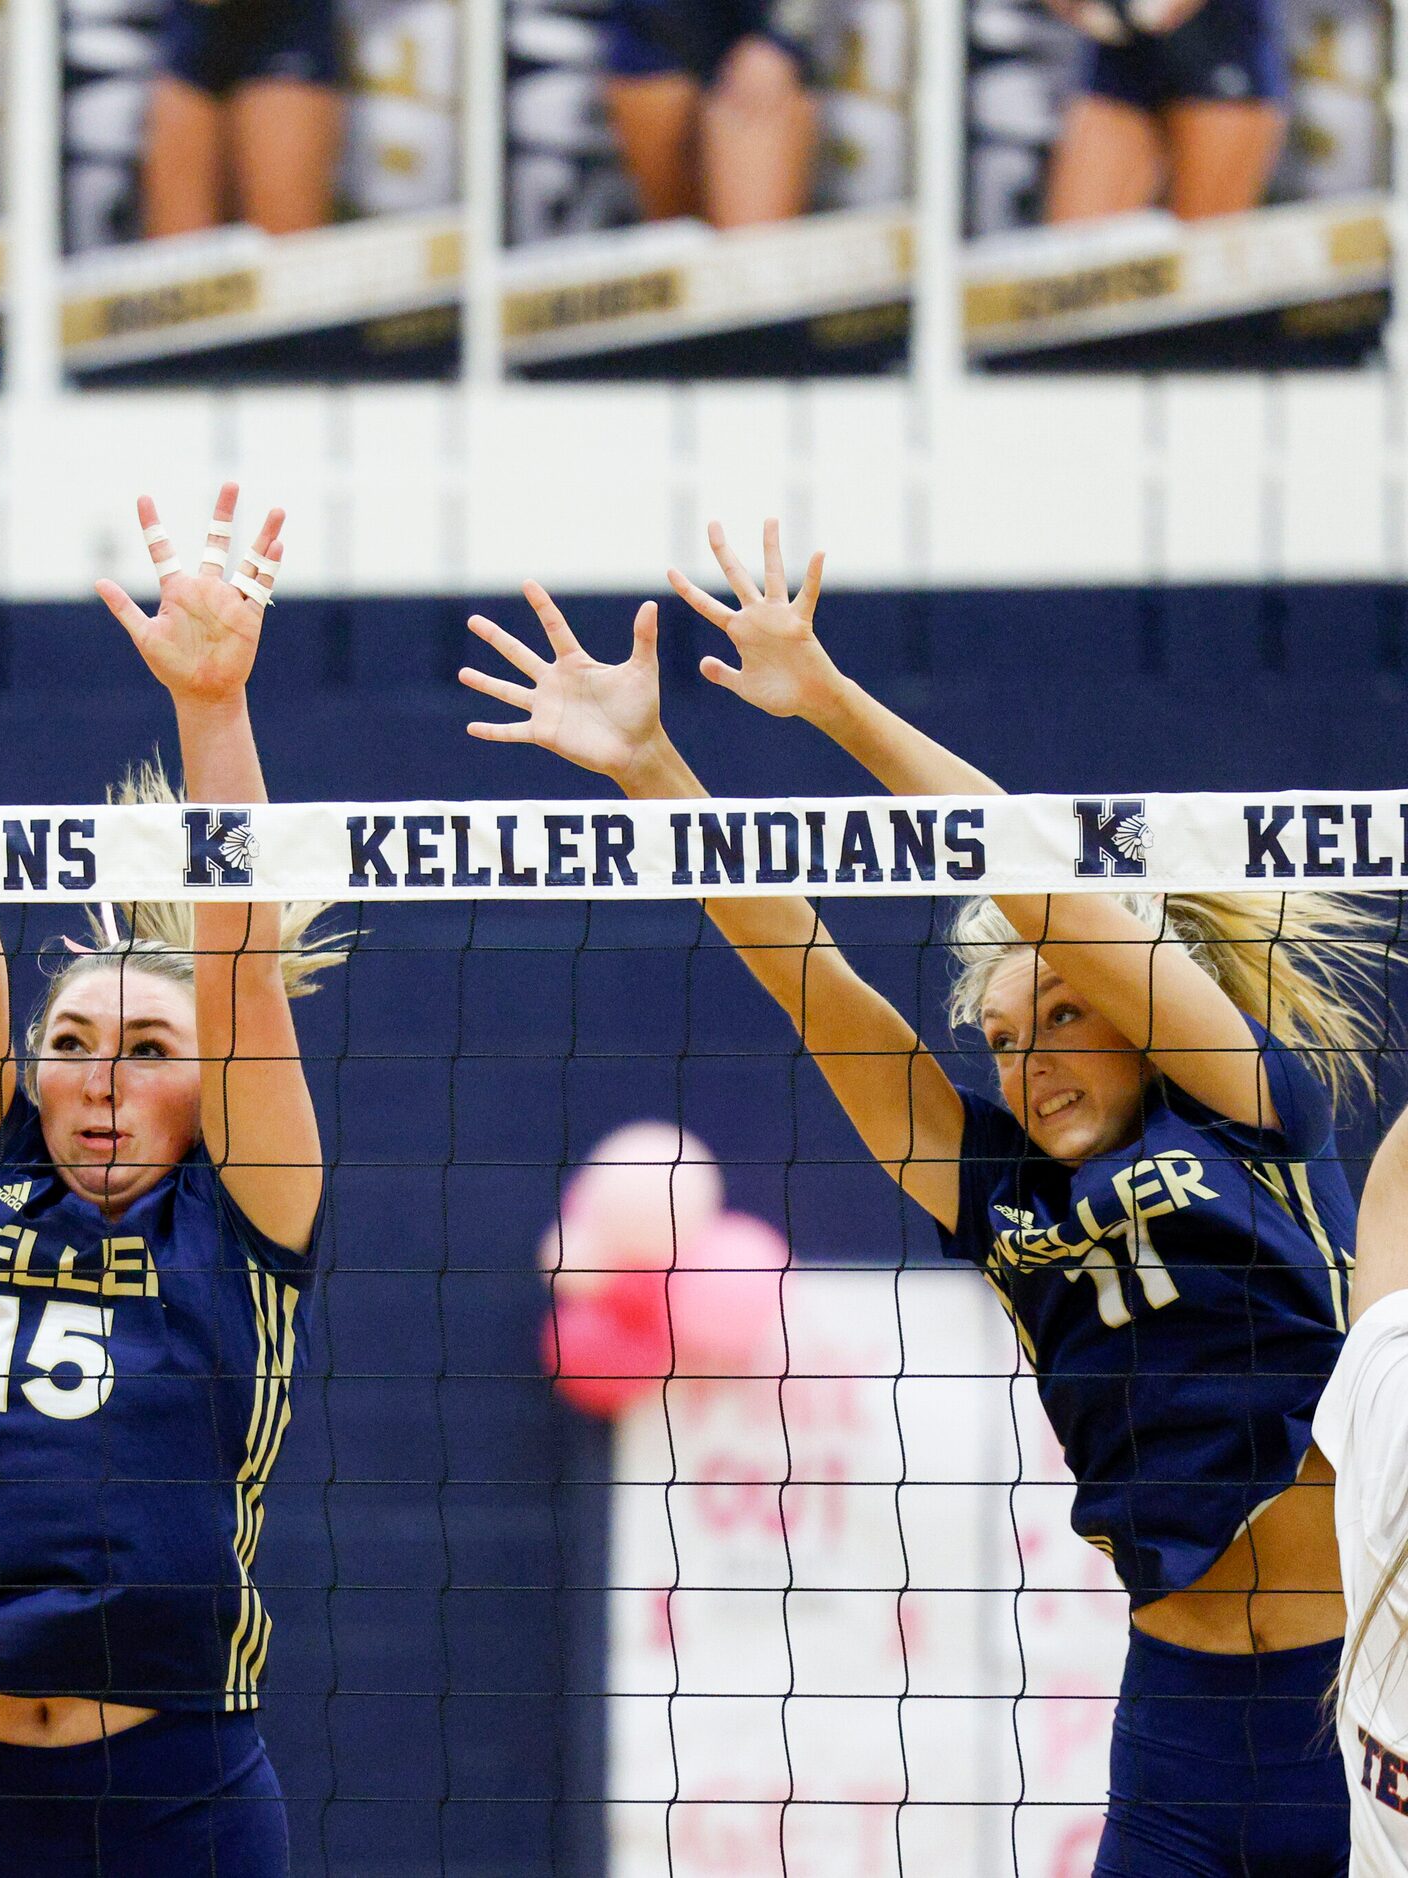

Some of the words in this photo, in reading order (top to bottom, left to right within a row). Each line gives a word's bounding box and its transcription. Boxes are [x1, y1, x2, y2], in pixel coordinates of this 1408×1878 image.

[182, 809, 252, 887] K
[347, 815, 637, 887] KELLER
[671, 809, 985, 885] INDIANS
[1073, 799, 1146, 878] K
[1244, 804, 1408, 878] KEL
[997, 1149, 1221, 1273] KELLER
[1064, 1219, 1180, 1329] 11
[1357, 1725, 1408, 1817] TE
